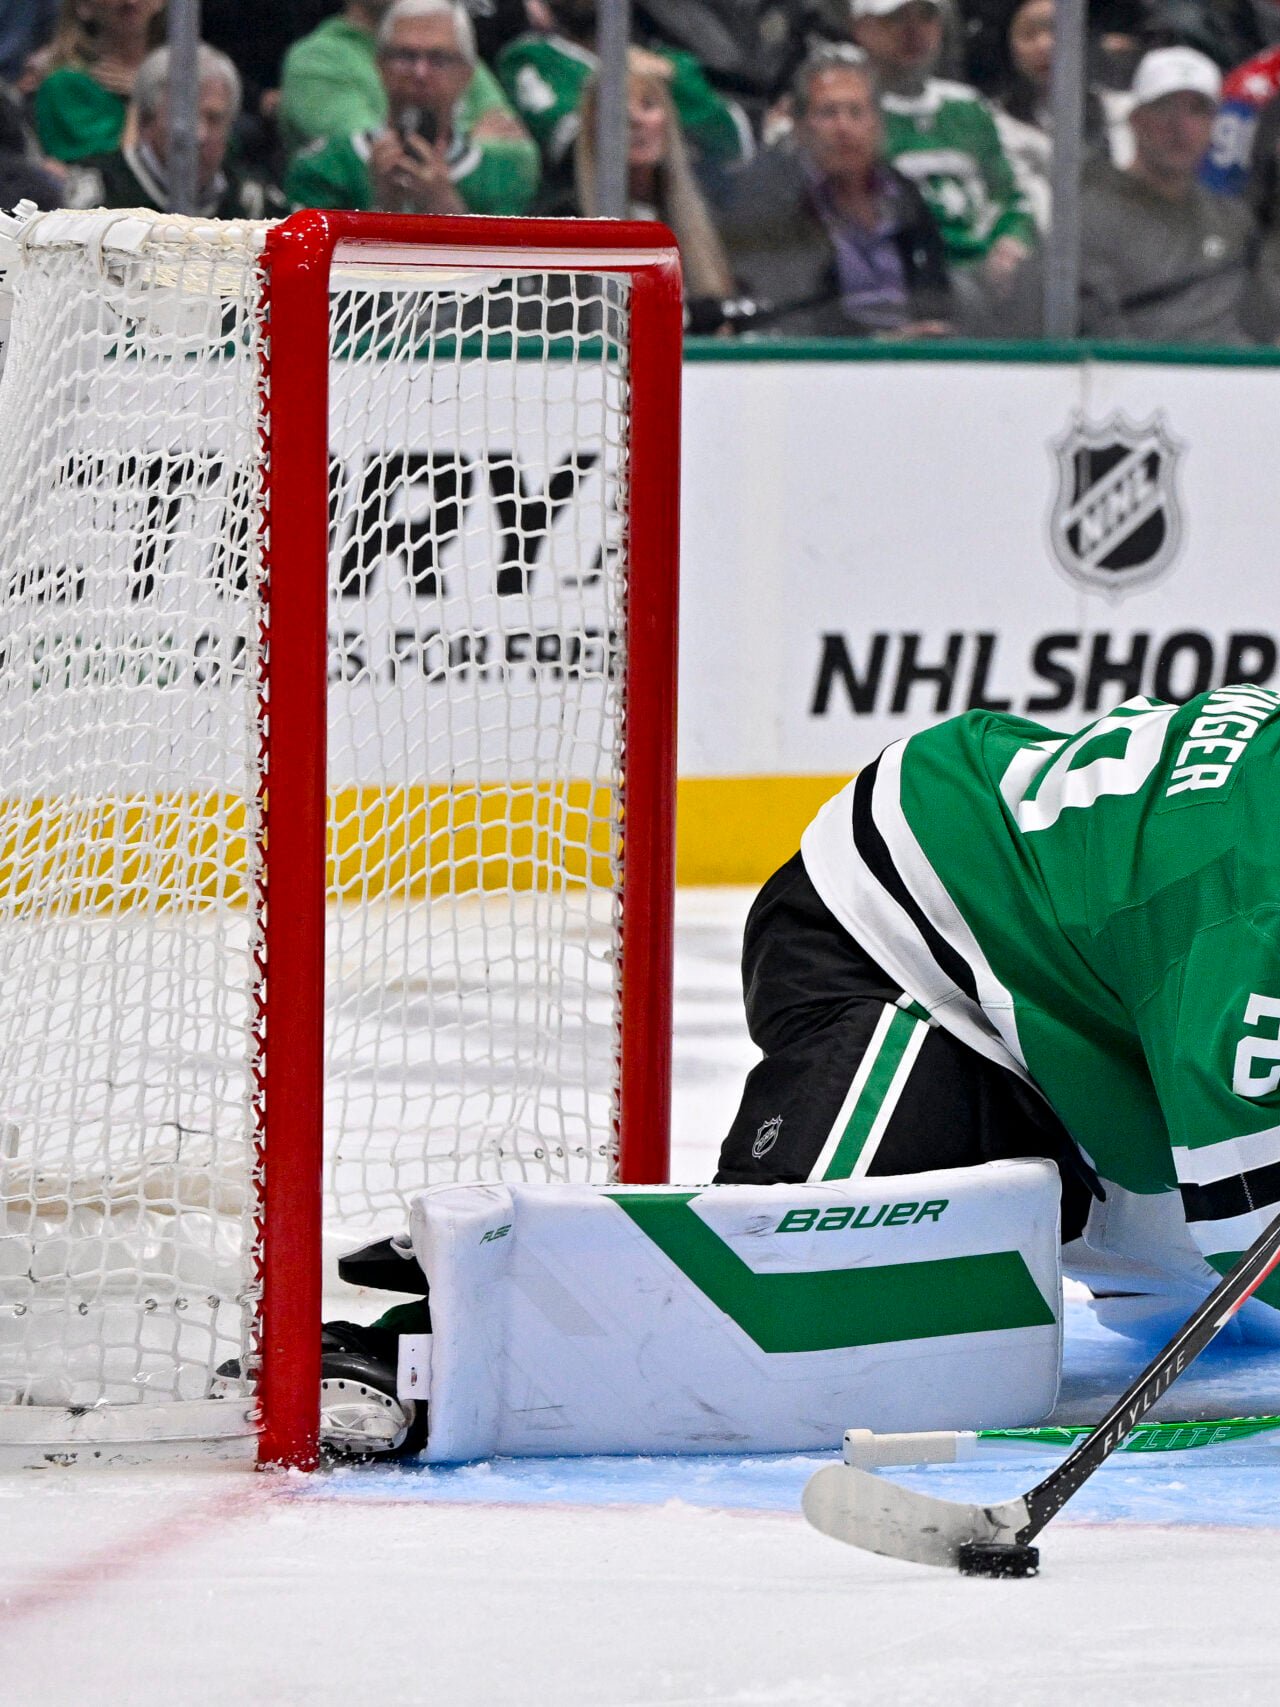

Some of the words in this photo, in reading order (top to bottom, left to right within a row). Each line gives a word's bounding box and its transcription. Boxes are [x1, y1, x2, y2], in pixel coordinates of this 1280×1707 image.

[775, 1199, 949, 1234] BAUER
[1102, 1350, 1187, 1456] FLYLITE
[1067, 1425, 1233, 1451] FYLITE
